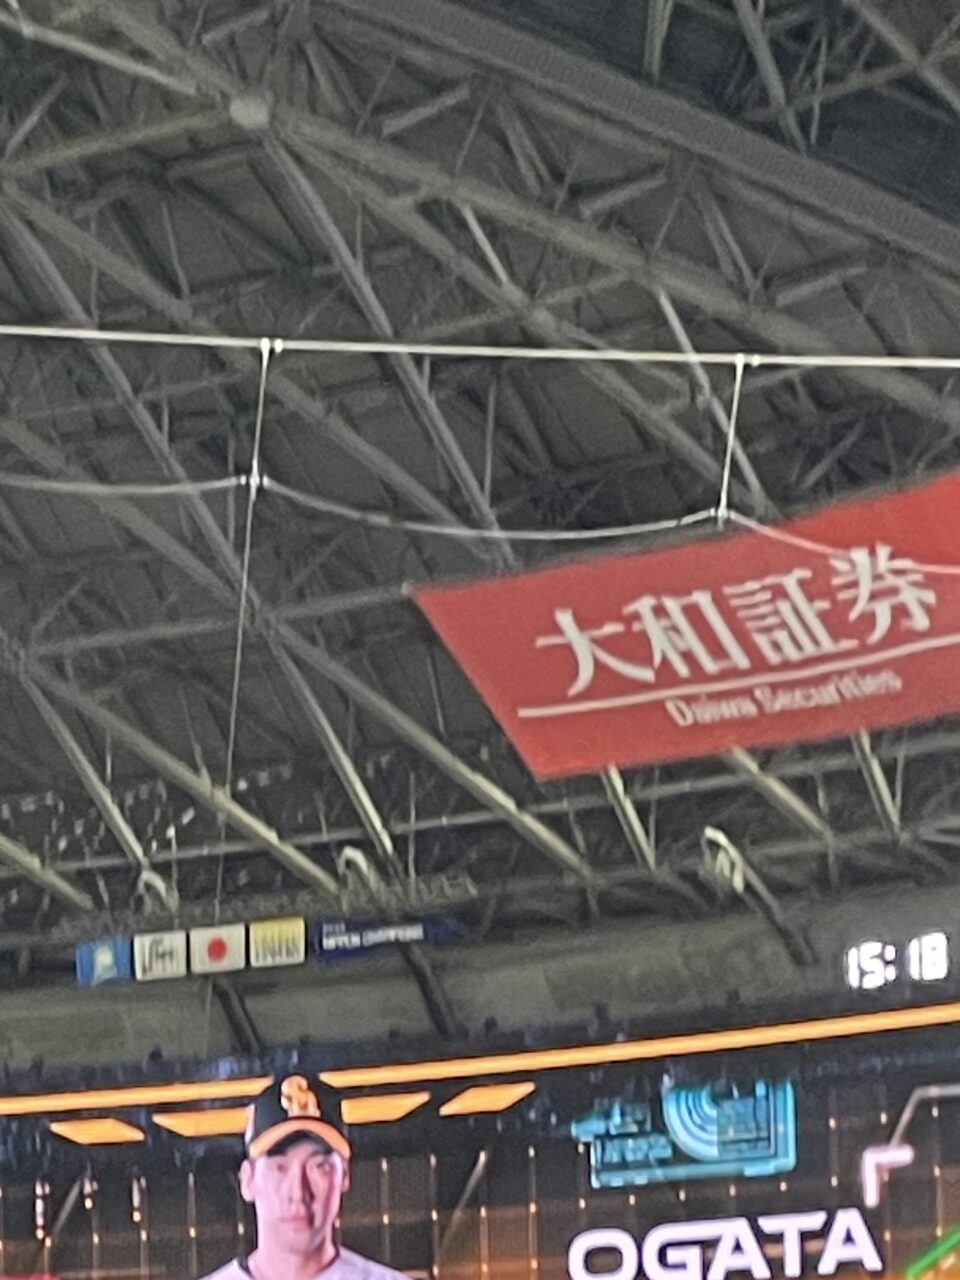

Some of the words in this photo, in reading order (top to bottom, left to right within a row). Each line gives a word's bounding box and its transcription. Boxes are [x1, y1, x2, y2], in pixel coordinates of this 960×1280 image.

[536, 543, 936, 697] 大和証券
[665, 692, 758, 727] Daiwa
[754, 669, 902, 714] Securities
